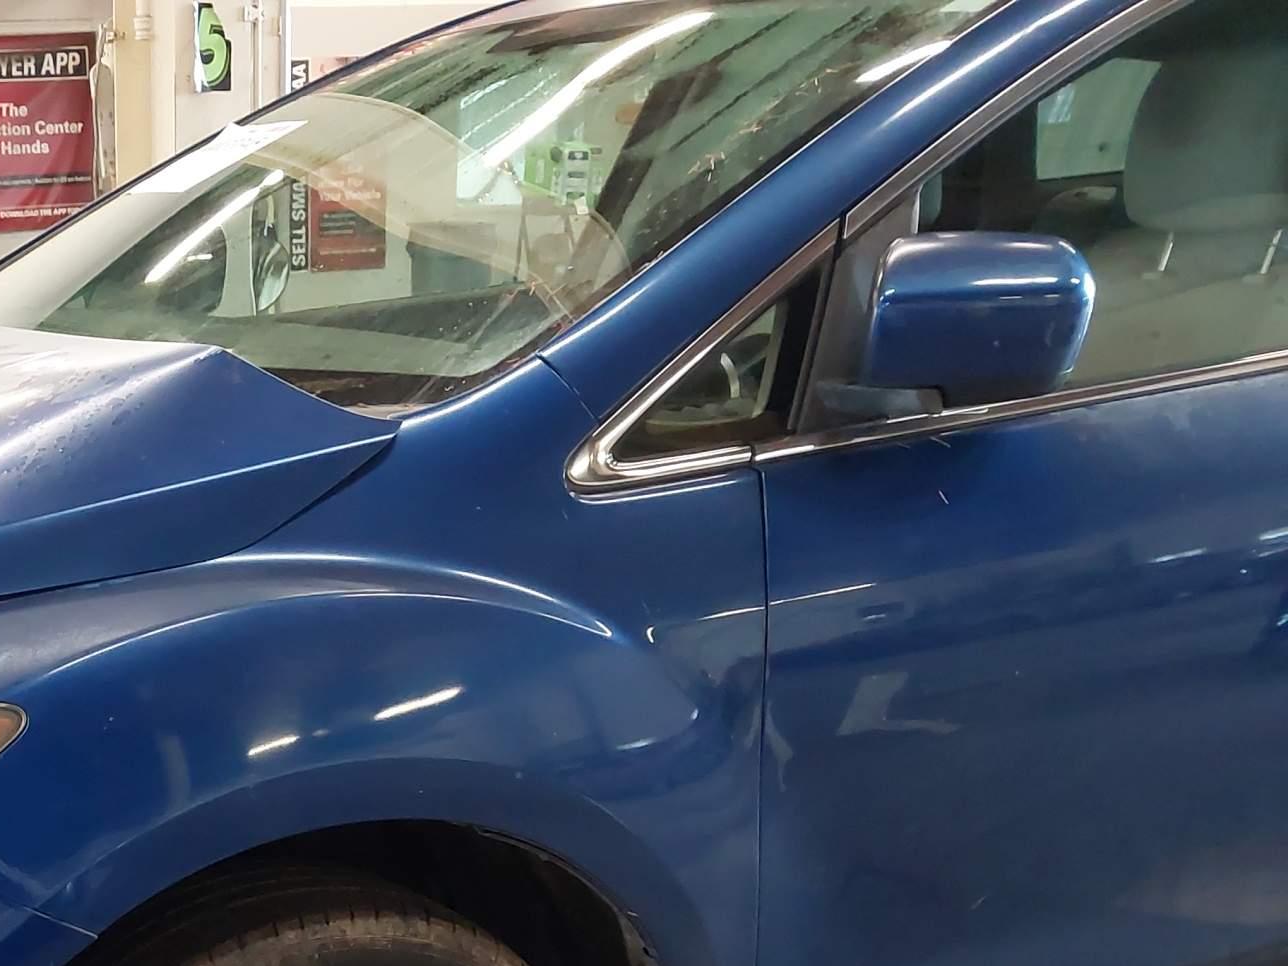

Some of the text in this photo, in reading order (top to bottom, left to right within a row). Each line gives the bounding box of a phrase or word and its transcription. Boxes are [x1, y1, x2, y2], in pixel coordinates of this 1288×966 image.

[41, 52, 81, 76] APP
[0, 102, 28, 117] The
[35, 120, 84, 135] Center
[1, 140, 50, 155] Hands
[0, 209, 39, 219] DOWNLOAD
[40, 208, 53, 217] THE
[53, 207, 67, 216] APP
[291, 226, 306, 267] SELL
